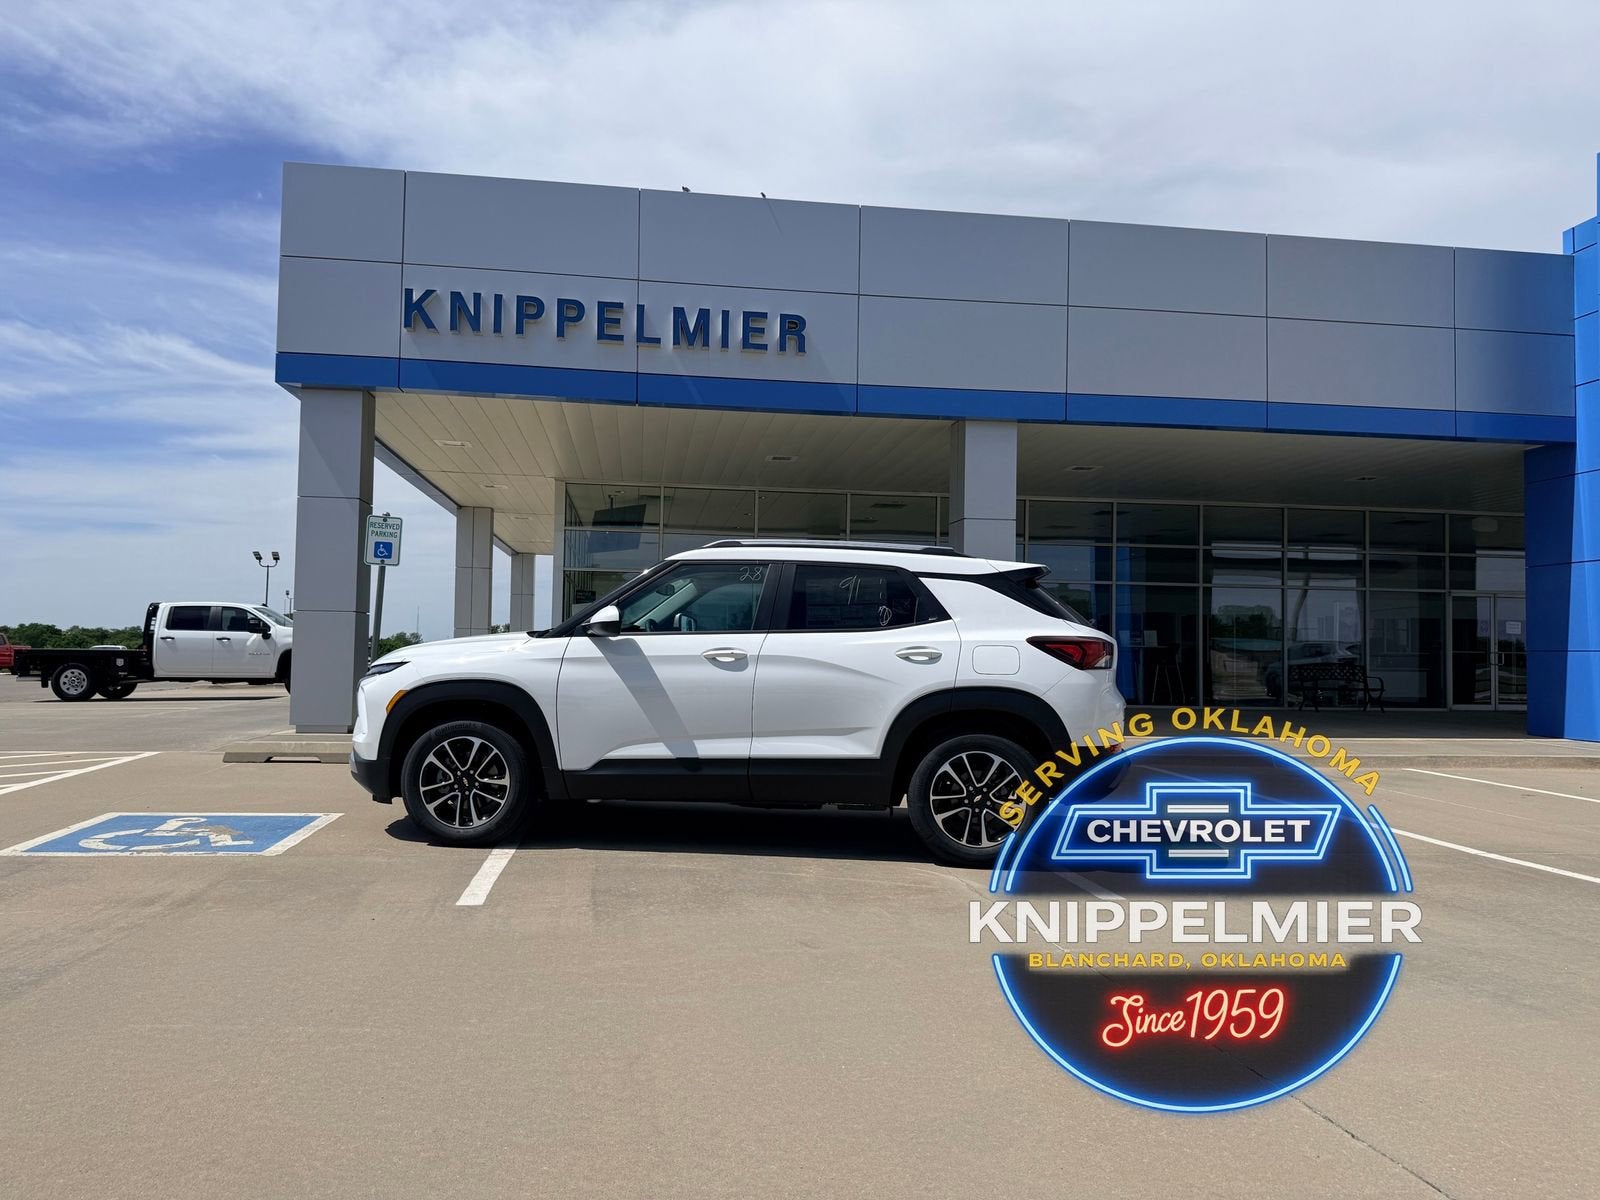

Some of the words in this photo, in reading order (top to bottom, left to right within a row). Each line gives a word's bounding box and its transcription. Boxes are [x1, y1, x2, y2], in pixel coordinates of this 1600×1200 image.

[403, 287, 808, 354] KNIPPELMIER
[370, 522, 400, 530] RESERVED
[371, 530, 398, 538] PARKING
